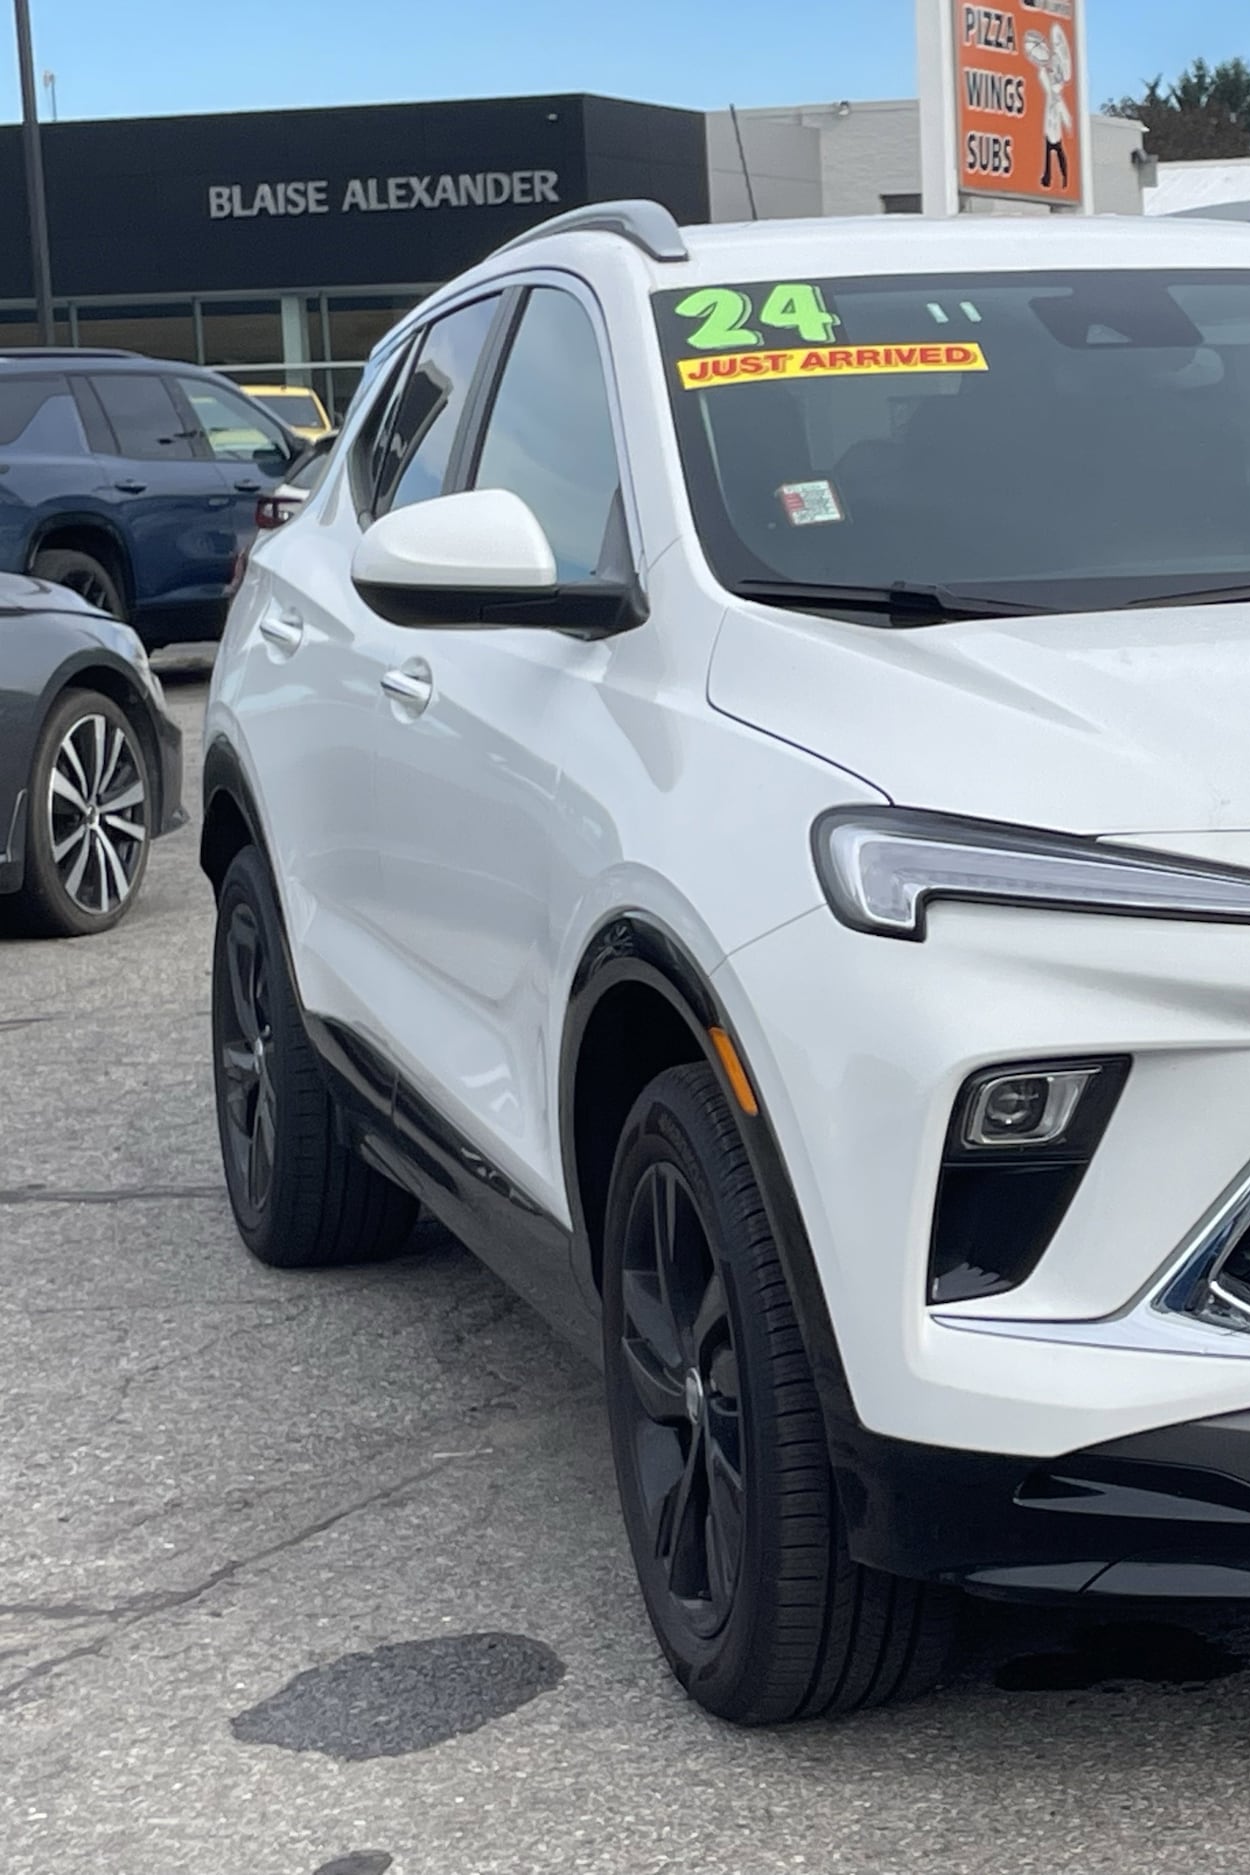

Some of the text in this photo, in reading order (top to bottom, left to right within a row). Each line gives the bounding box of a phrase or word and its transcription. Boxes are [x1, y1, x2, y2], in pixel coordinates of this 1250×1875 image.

[963, 6, 1017, 53] PIZZA
[965, 69, 1025, 116] WINGS
[966, 132, 1013, 175] SUBS
[208, 169, 560, 218] BLAISE ALEXANDER
[674, 283, 842, 350] 24
[687, 346, 979, 382] JUST ARRIVED
